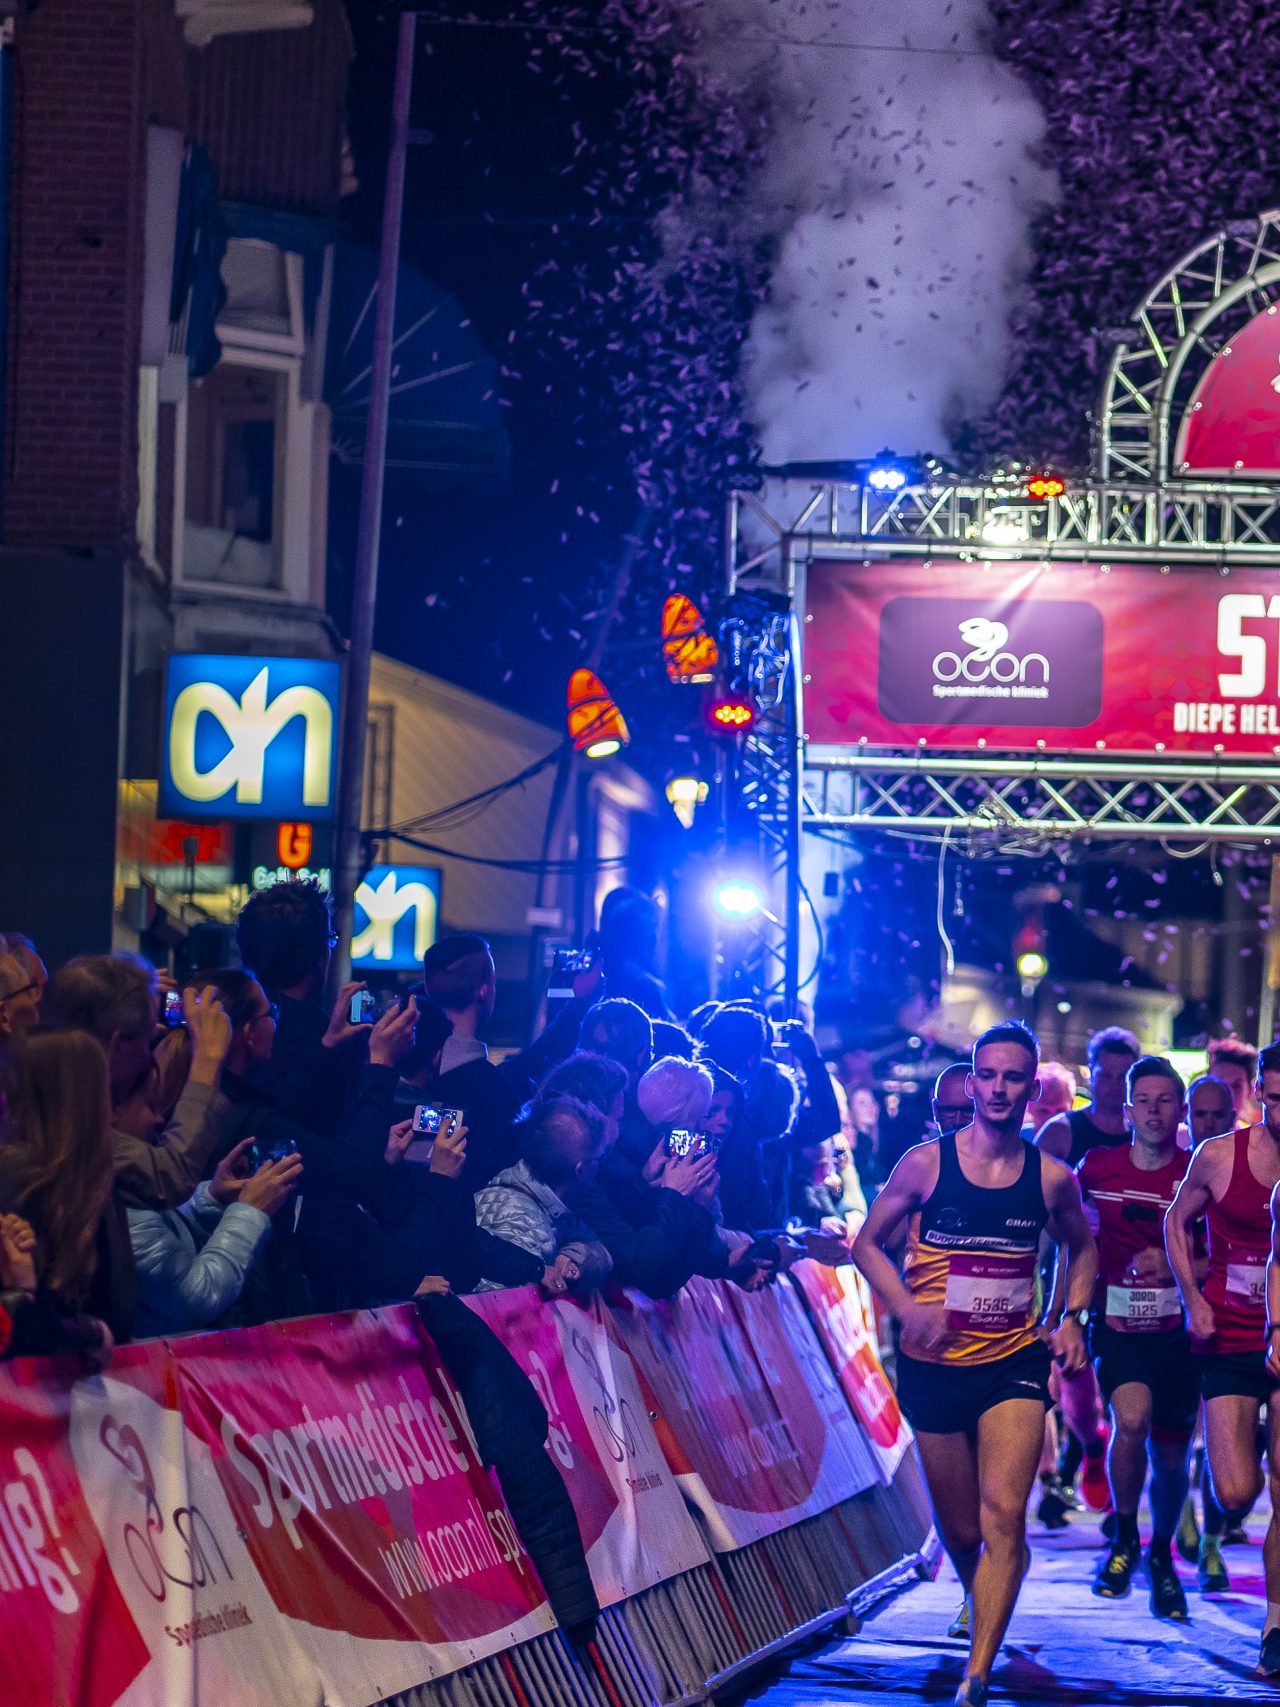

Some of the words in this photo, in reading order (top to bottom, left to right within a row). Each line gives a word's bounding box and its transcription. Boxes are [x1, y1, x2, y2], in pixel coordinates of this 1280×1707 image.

[1173, 702, 1236, 734] DIEPE
[1129, 1290, 1157, 1303] JORDI
[1127, 1303, 1159, 1317] 3125
